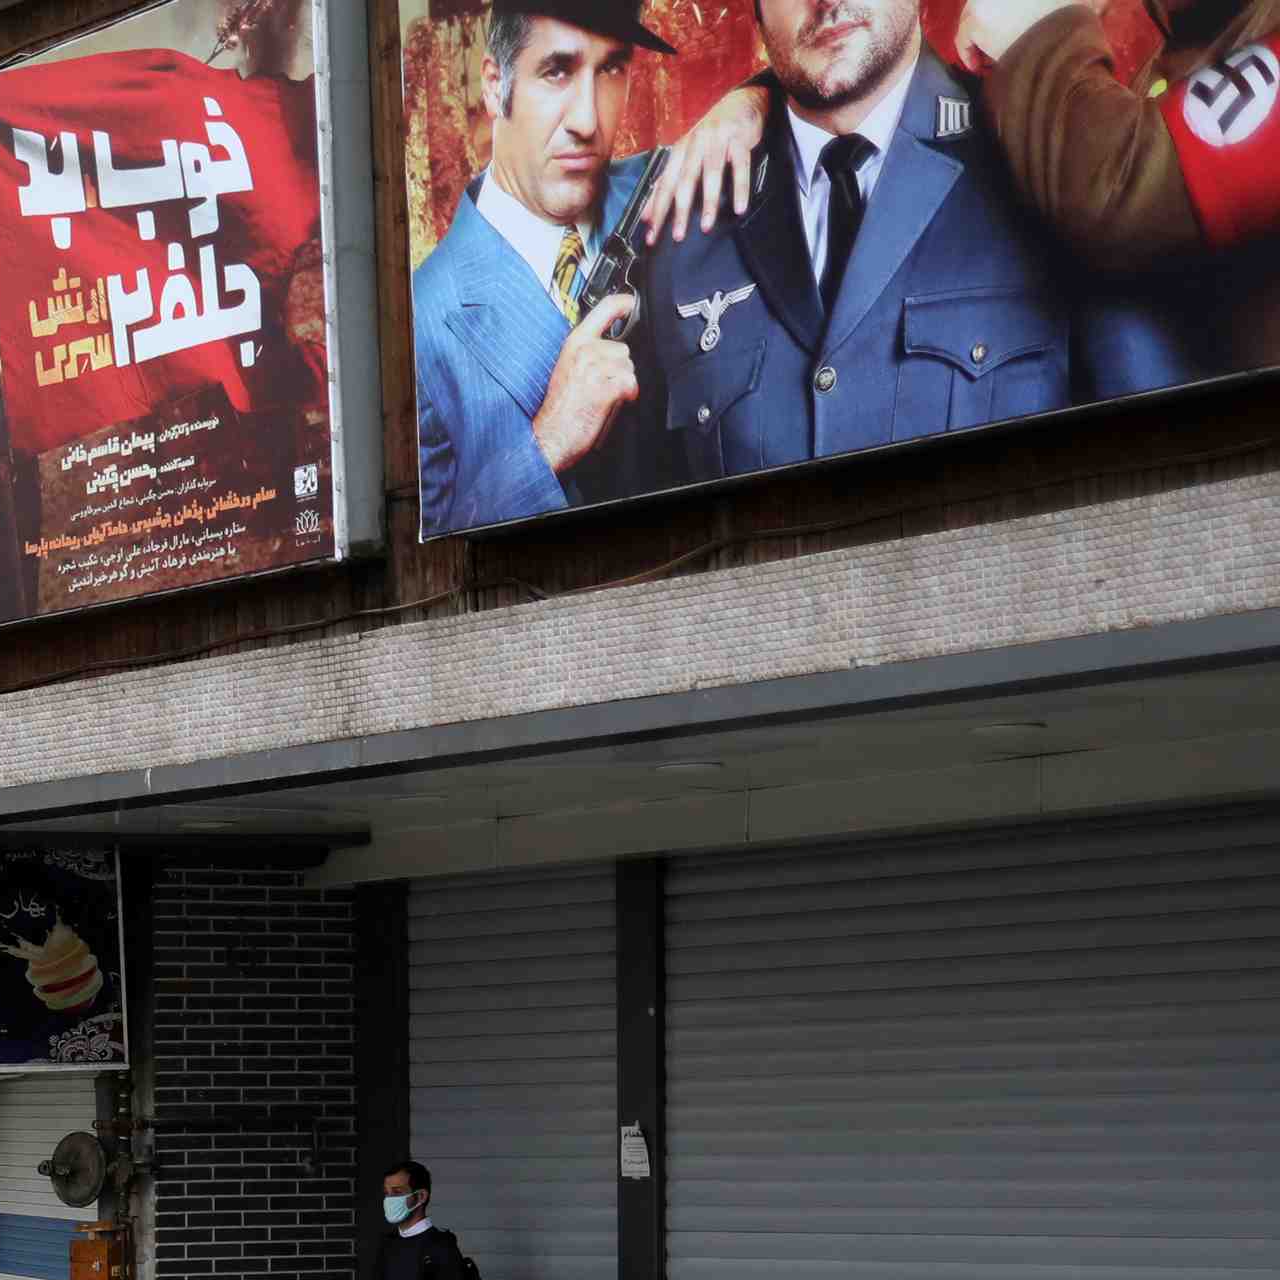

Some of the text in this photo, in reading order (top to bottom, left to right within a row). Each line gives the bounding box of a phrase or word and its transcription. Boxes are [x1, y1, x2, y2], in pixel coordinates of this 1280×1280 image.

[120, 431, 156, 456] پیمان
[86, 463, 120, 495] چگینی
[120, 462, 157, 487] محسن
